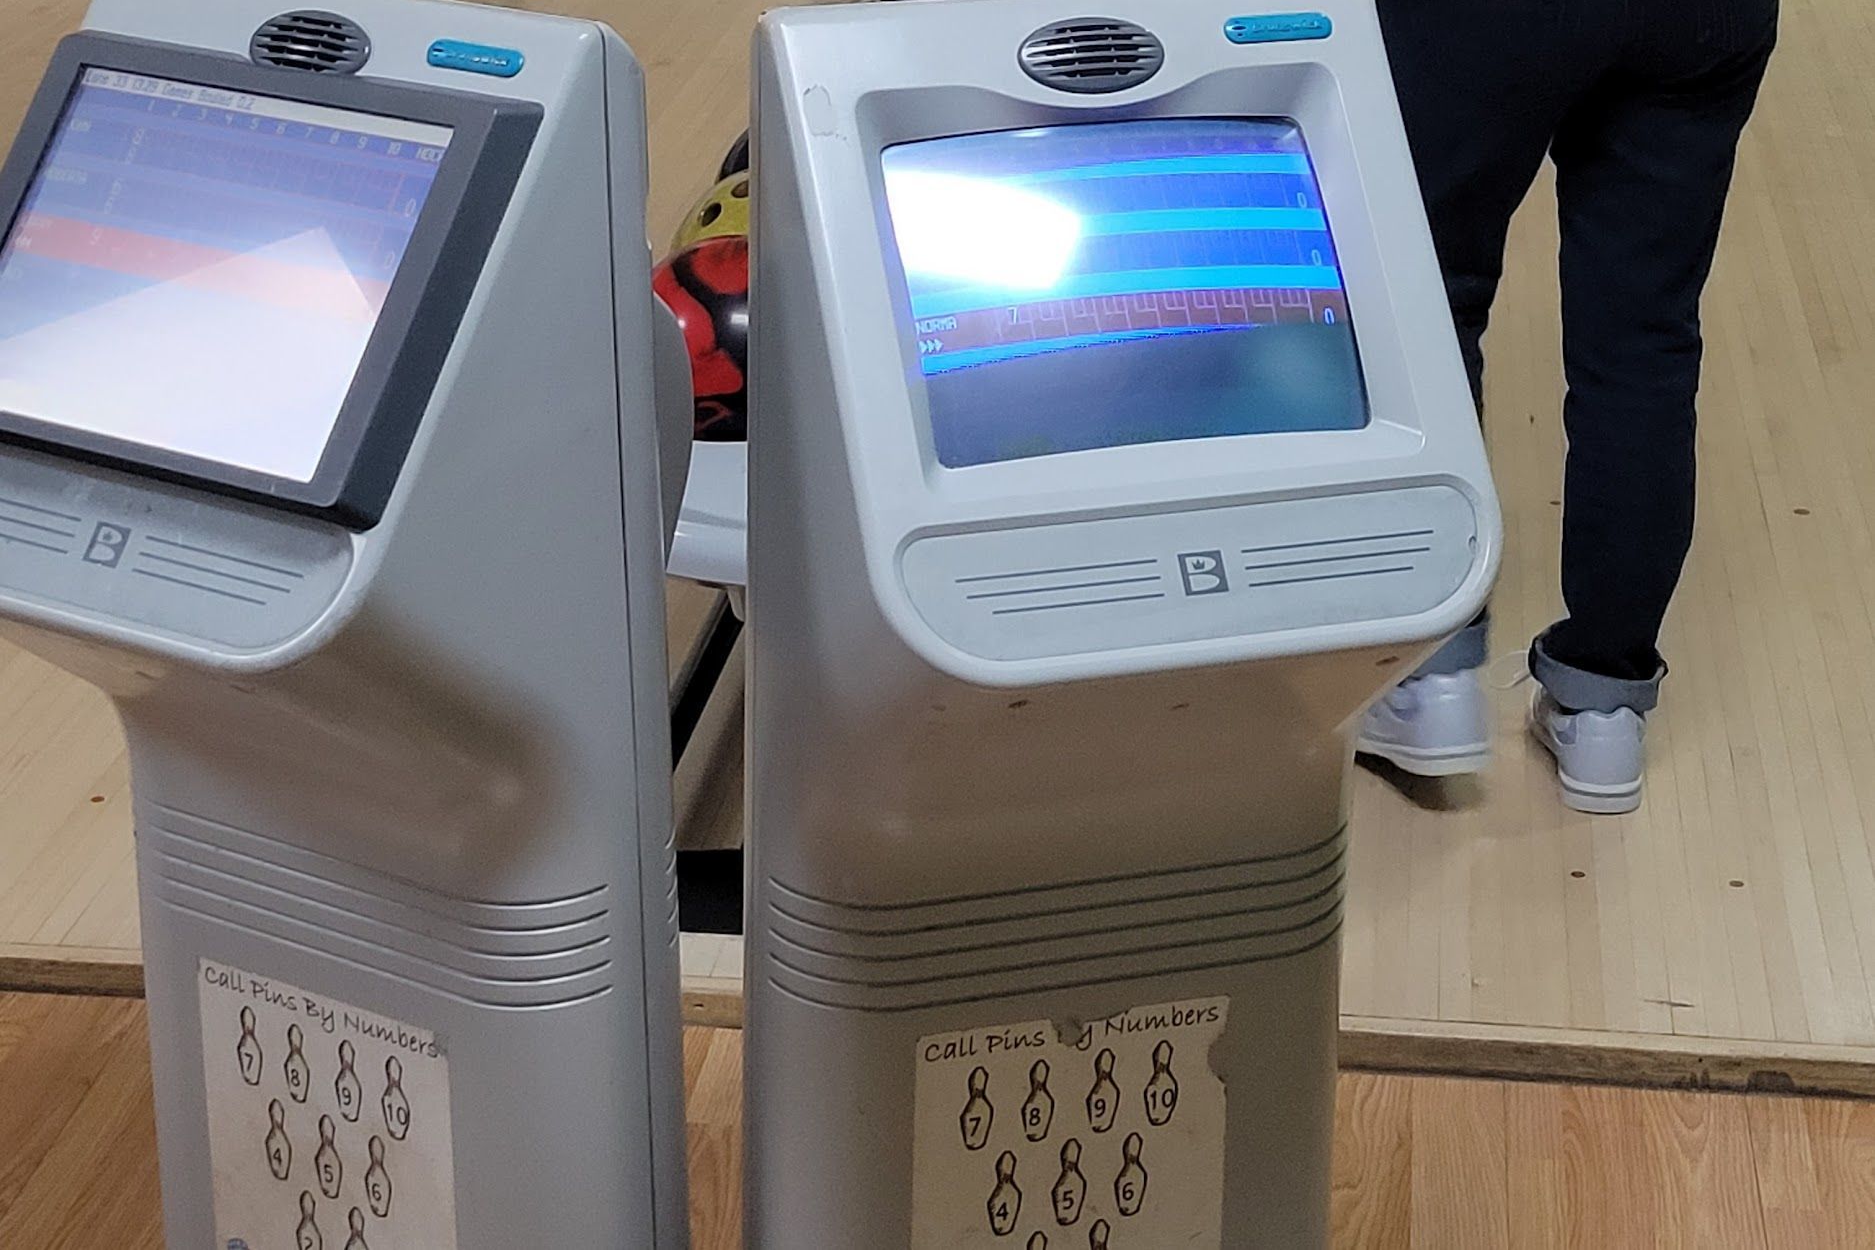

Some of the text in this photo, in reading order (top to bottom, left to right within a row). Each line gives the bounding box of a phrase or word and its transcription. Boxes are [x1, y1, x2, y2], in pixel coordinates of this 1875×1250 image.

[357, 137, 369, 150] 9
[386, 141, 402, 156] 10
[915, 316, 958, 336] NORMA
[1008, 306, 1020, 325] 7
[250, 979, 298, 1012] Pins
[302, 997, 336, 1034] By
[343, 1012, 440, 1059] Numbers
[986, 1029, 1046, 1054] Pins
[1103, 1004, 1220, 1037] Numbers
[244, 1052, 409, 1126] 7 8 9 10
[969, 1088, 1175, 1137] 7 8 9 10
[272, 1147, 382, 1202] 4 5 6
[995, 1181, 1134, 1222] 4 5 6
